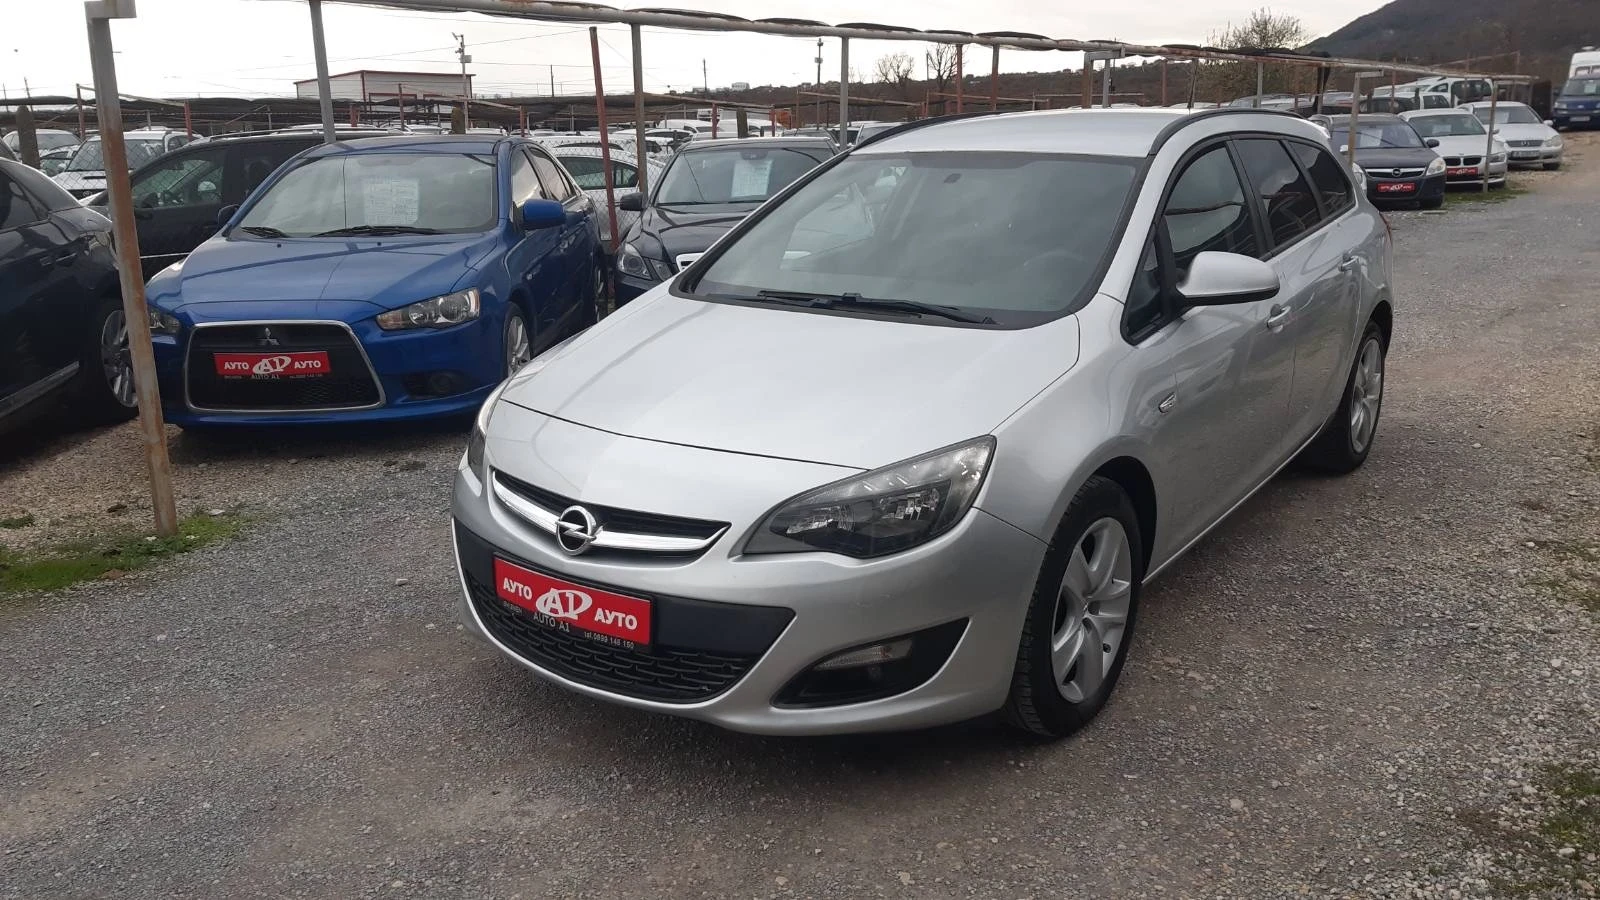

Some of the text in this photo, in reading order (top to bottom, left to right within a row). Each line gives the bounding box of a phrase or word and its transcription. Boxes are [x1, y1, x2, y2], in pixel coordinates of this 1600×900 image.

[224, 361, 249, 370] АУТО
[294, 360, 321, 369] АУТО
[503, 577, 533, 600] АУТО
[594, 607, 638, 630] АУТО
[533, 611, 570, 633] AUTO A1
